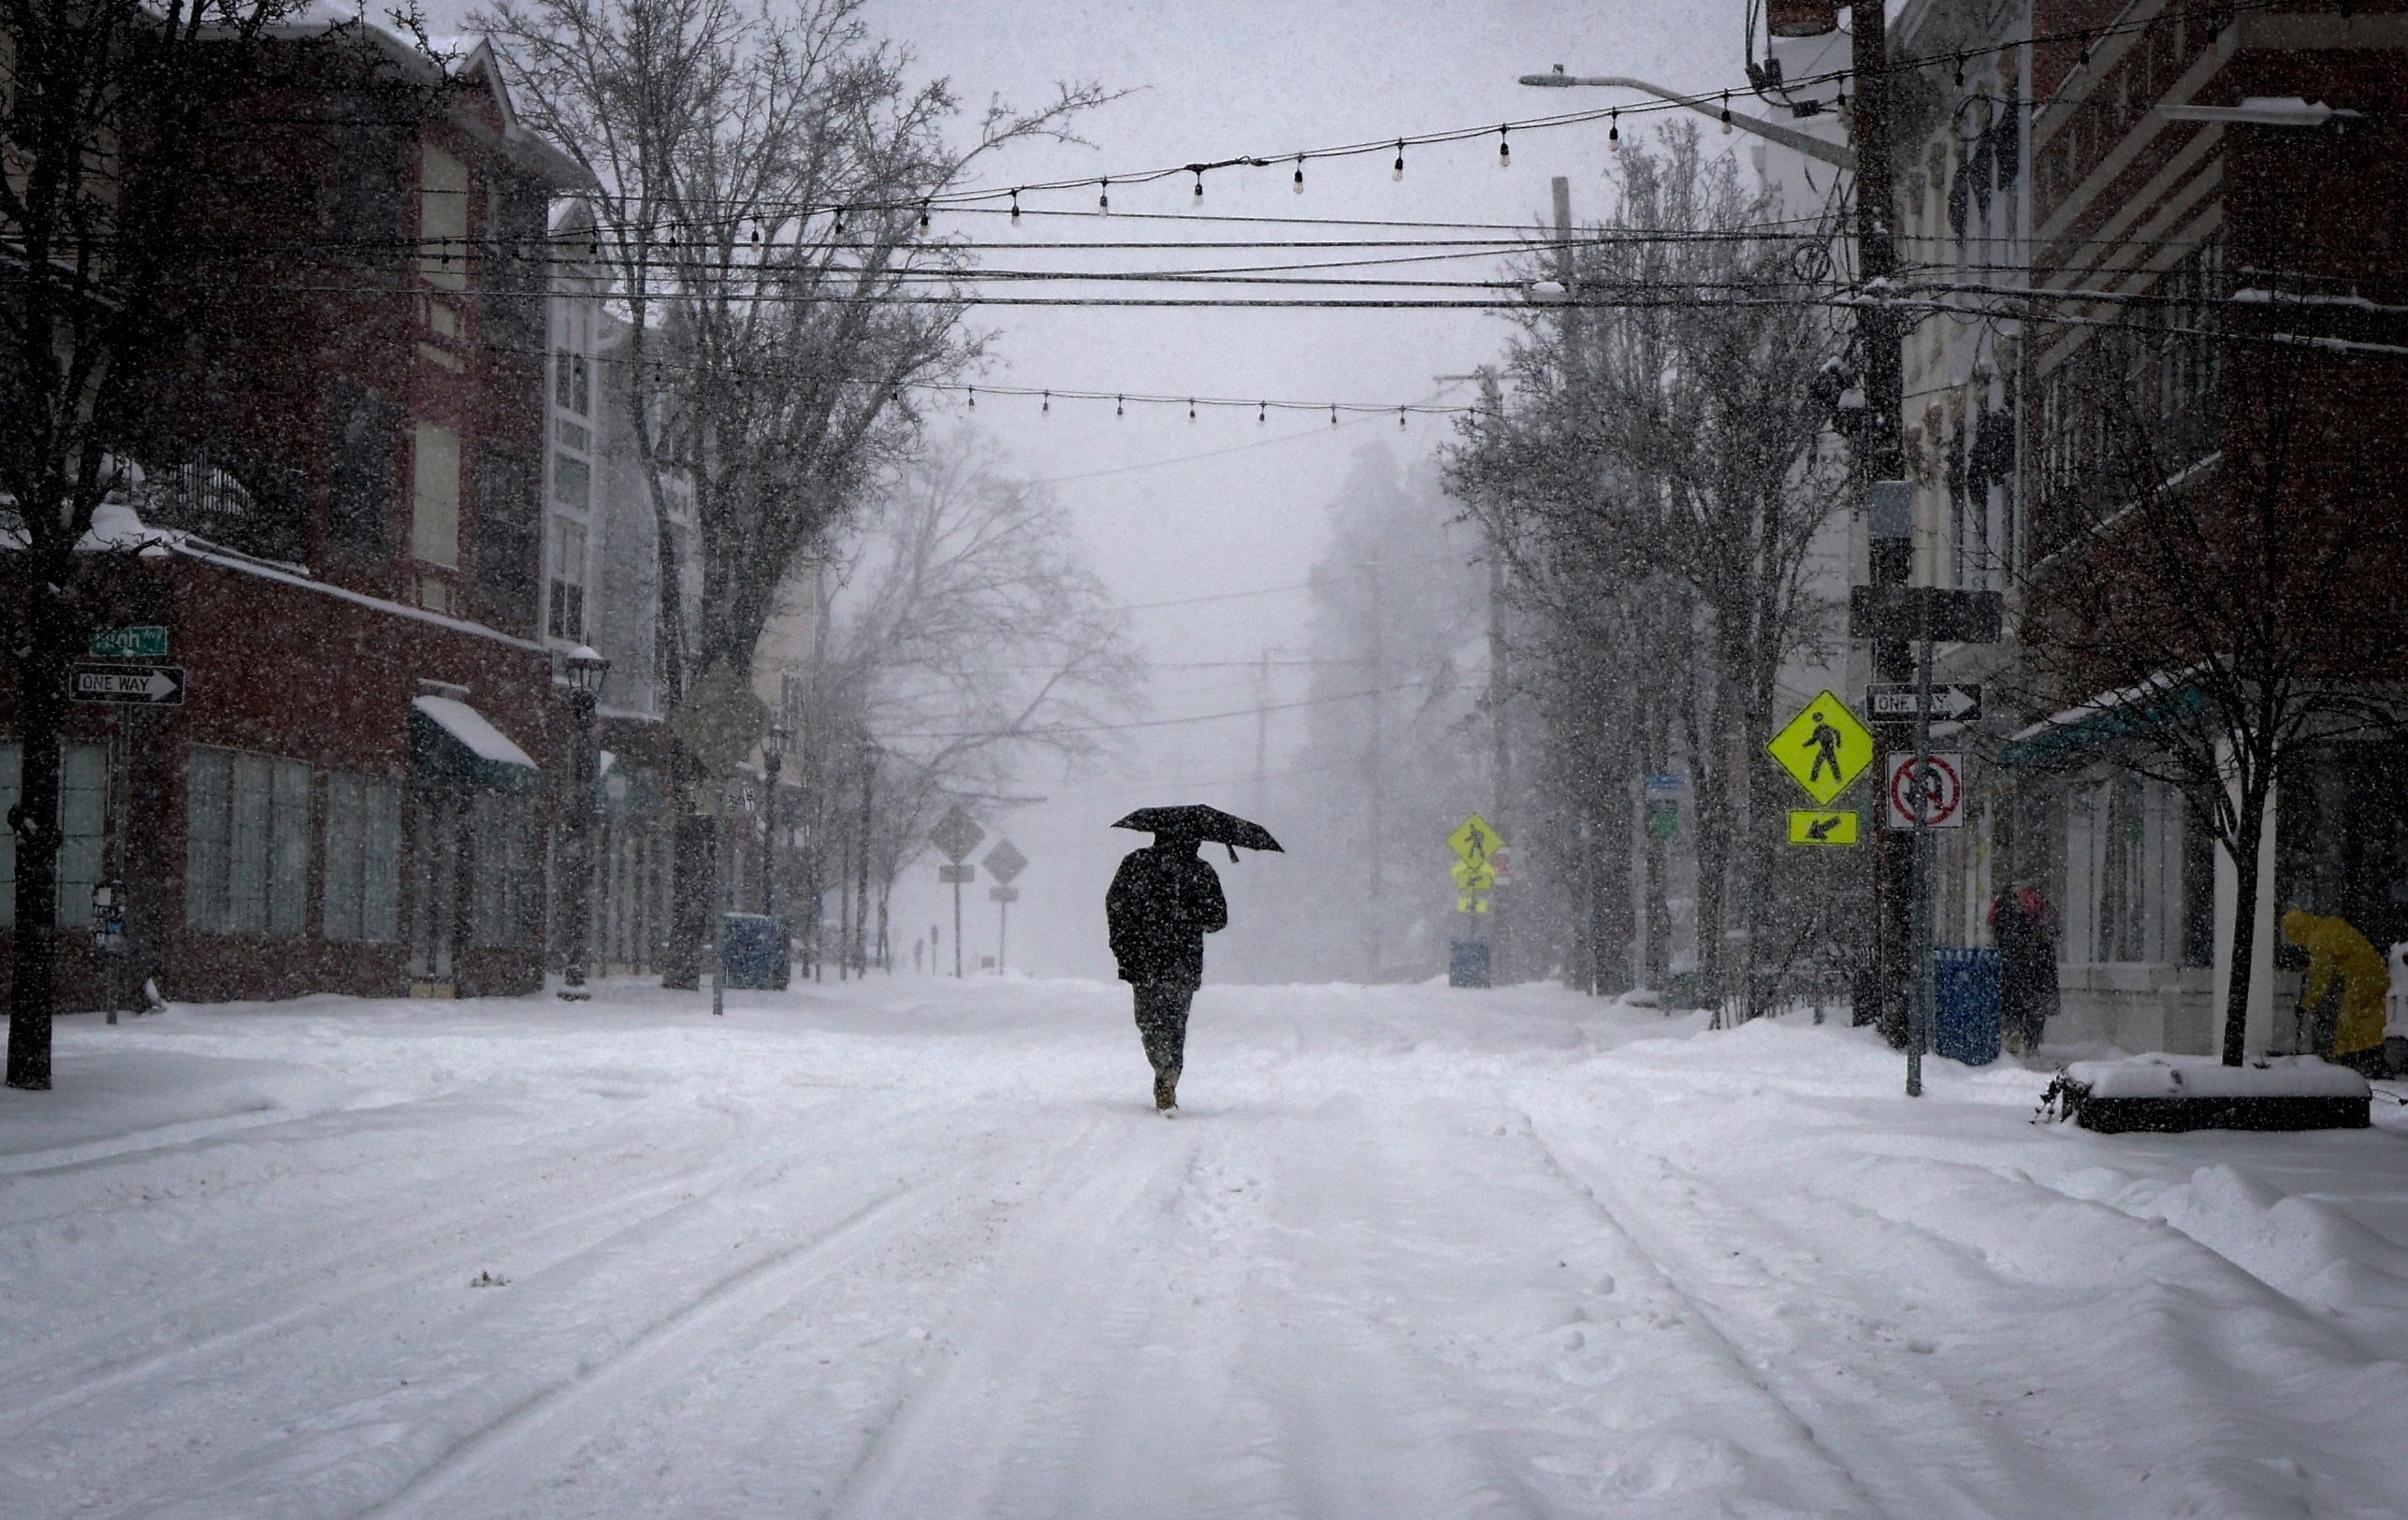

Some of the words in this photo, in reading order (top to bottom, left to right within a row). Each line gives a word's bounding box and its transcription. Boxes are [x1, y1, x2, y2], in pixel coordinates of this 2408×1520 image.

[82, 674, 113, 690] ONE
[118, 675, 150, 691] WAY
[1879, 695, 1909, 711] ONE
